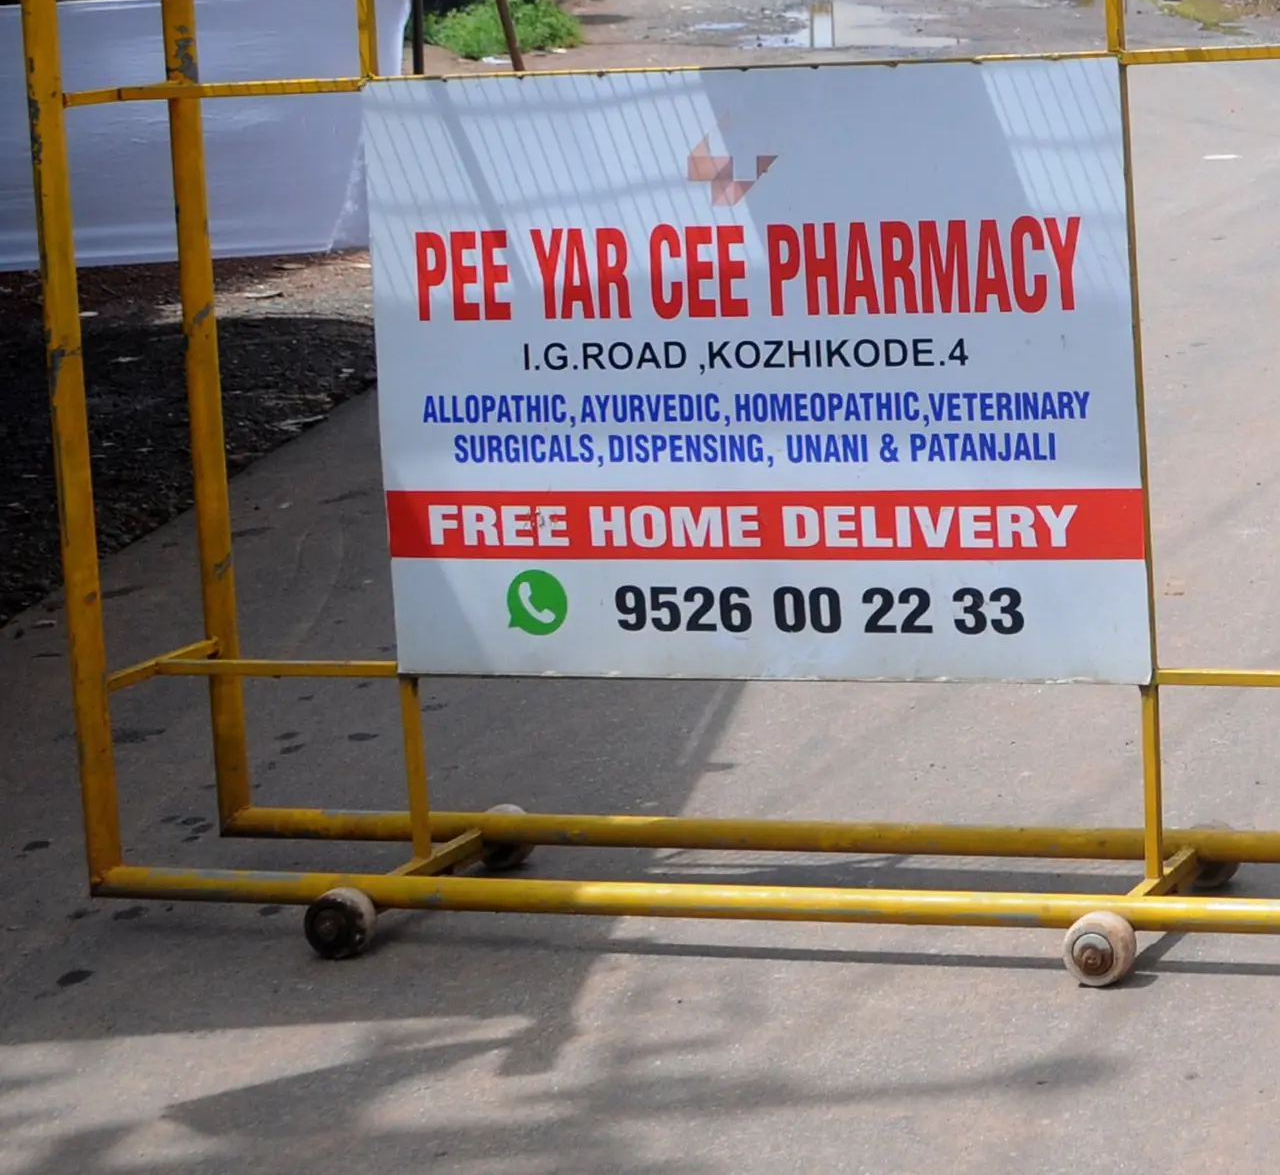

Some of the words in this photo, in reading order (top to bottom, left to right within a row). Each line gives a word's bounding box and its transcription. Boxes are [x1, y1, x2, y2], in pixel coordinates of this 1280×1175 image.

[415, 231, 511, 321] PEE
[530, 227, 632, 319] YAR
[650, 223, 748, 319] CEE
[768, 217, 1081, 316] PHARMACY
[523, 341, 687, 371] I.G.ROAD
[787, 433, 868, 464] UNANI
[880, 434, 900, 463] &
[910, 432, 1056, 463] PATANJALI
[429, 505, 569, 547] FREE
[590, 505, 761, 549] HOME
[784, 505, 1078, 549] DELIVERY
[615, 585, 752, 634] 9526
[774, 587, 842, 635] 00
[862, 587, 933, 635] 22
[953, 587, 1025, 635] 33
